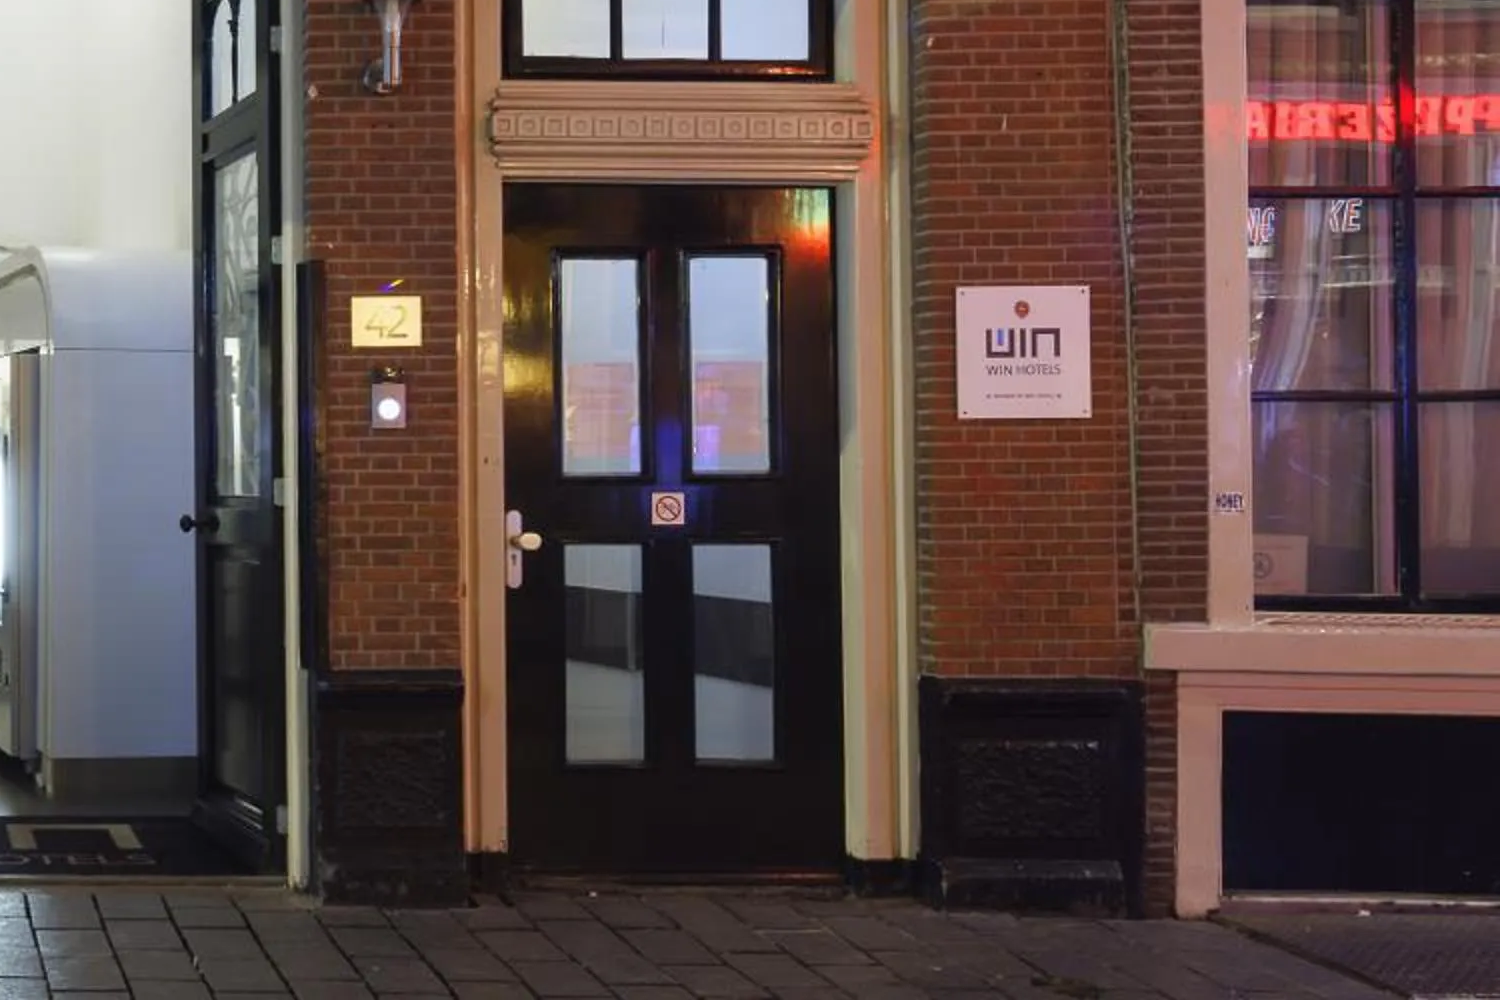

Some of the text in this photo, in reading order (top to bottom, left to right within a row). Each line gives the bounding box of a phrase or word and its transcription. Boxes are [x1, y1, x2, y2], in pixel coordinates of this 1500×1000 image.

[364, 305, 409, 339] 42
[986, 364, 1062, 376] WIN HOTELS
